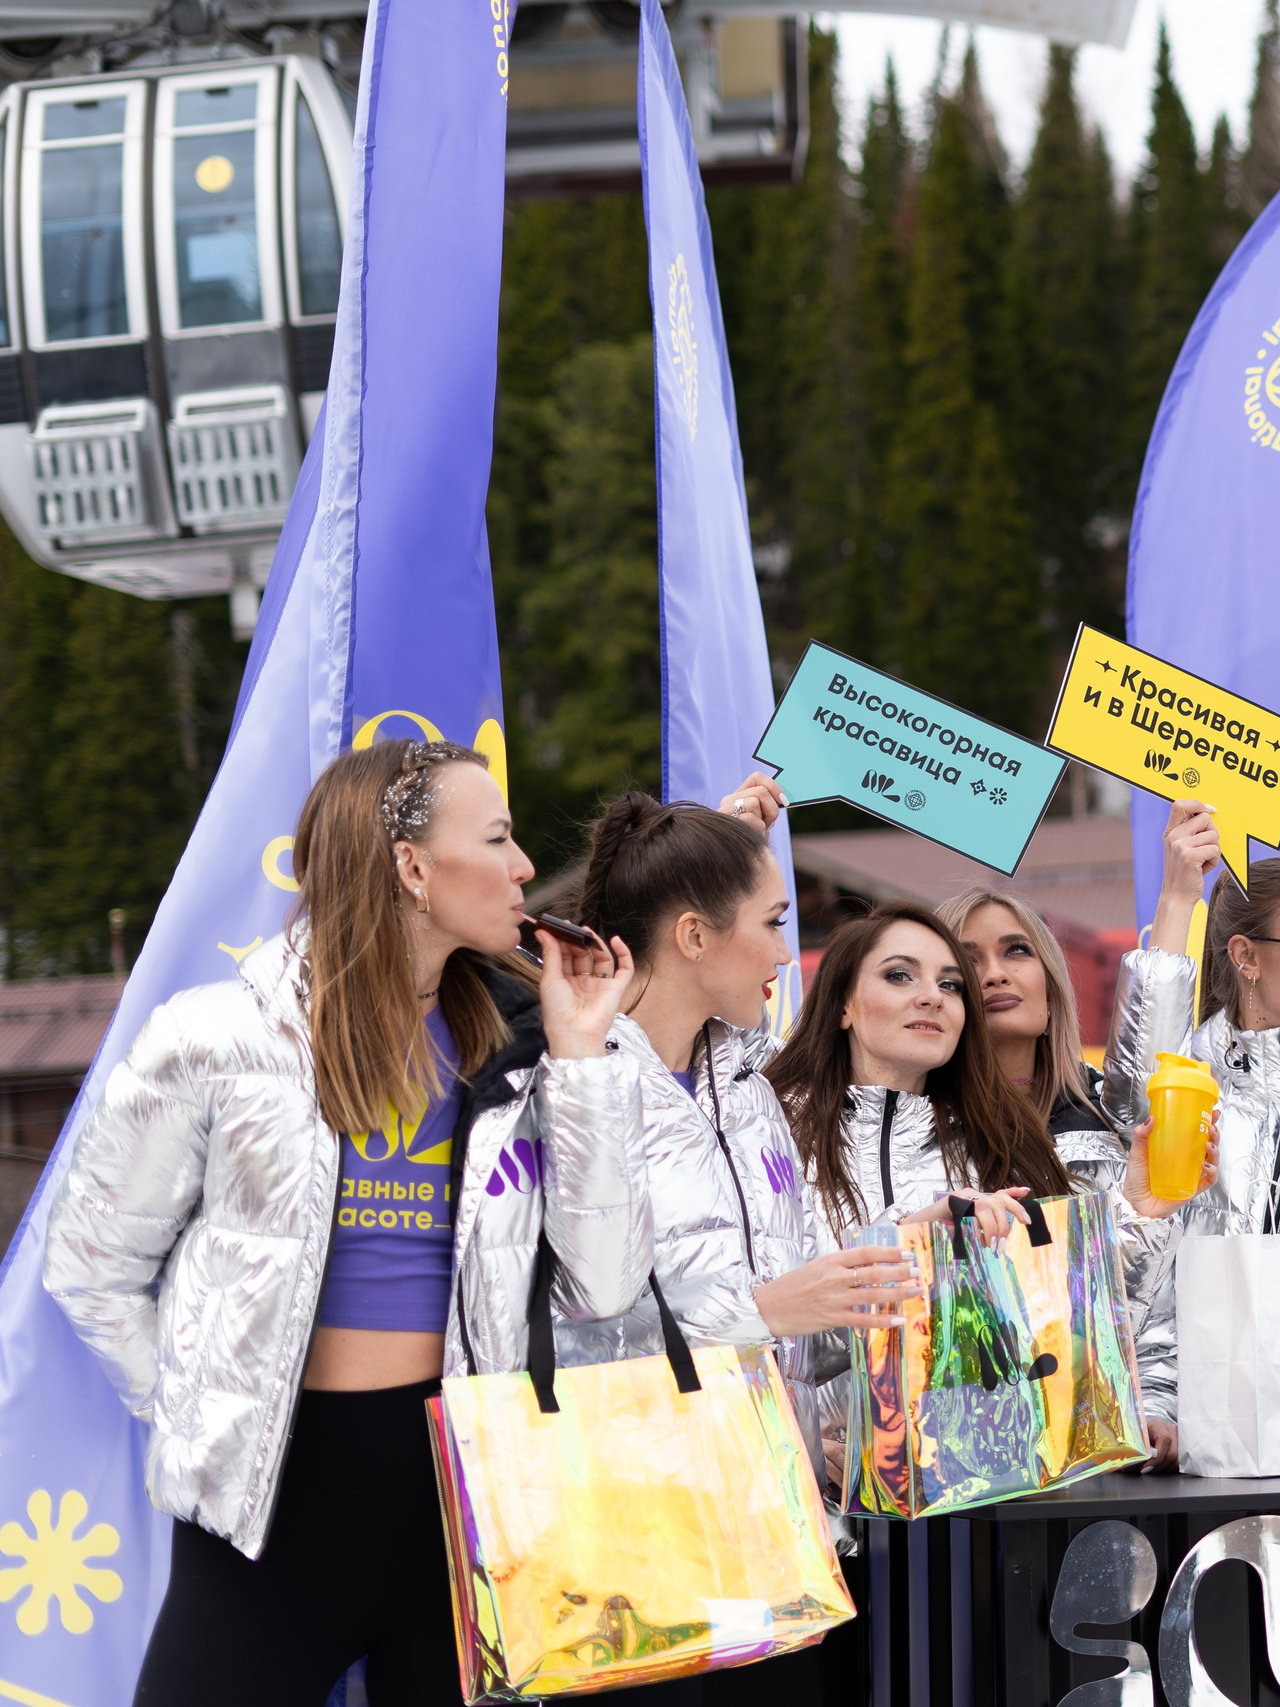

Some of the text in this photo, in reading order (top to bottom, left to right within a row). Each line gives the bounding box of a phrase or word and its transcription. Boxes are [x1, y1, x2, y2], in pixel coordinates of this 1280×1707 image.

[812, 706, 962, 786] красавица
[828, 673, 1022, 777] Высокогорная
[1084, 685, 1101, 708] и
[1108, 697, 1124, 717] в
[1130, 702, 1279, 789] Шерегеше
[1120, 664, 1260, 748] Красивая
[338, 1208, 433, 1229] асоте
[341, 1179, 434, 1201] авные
